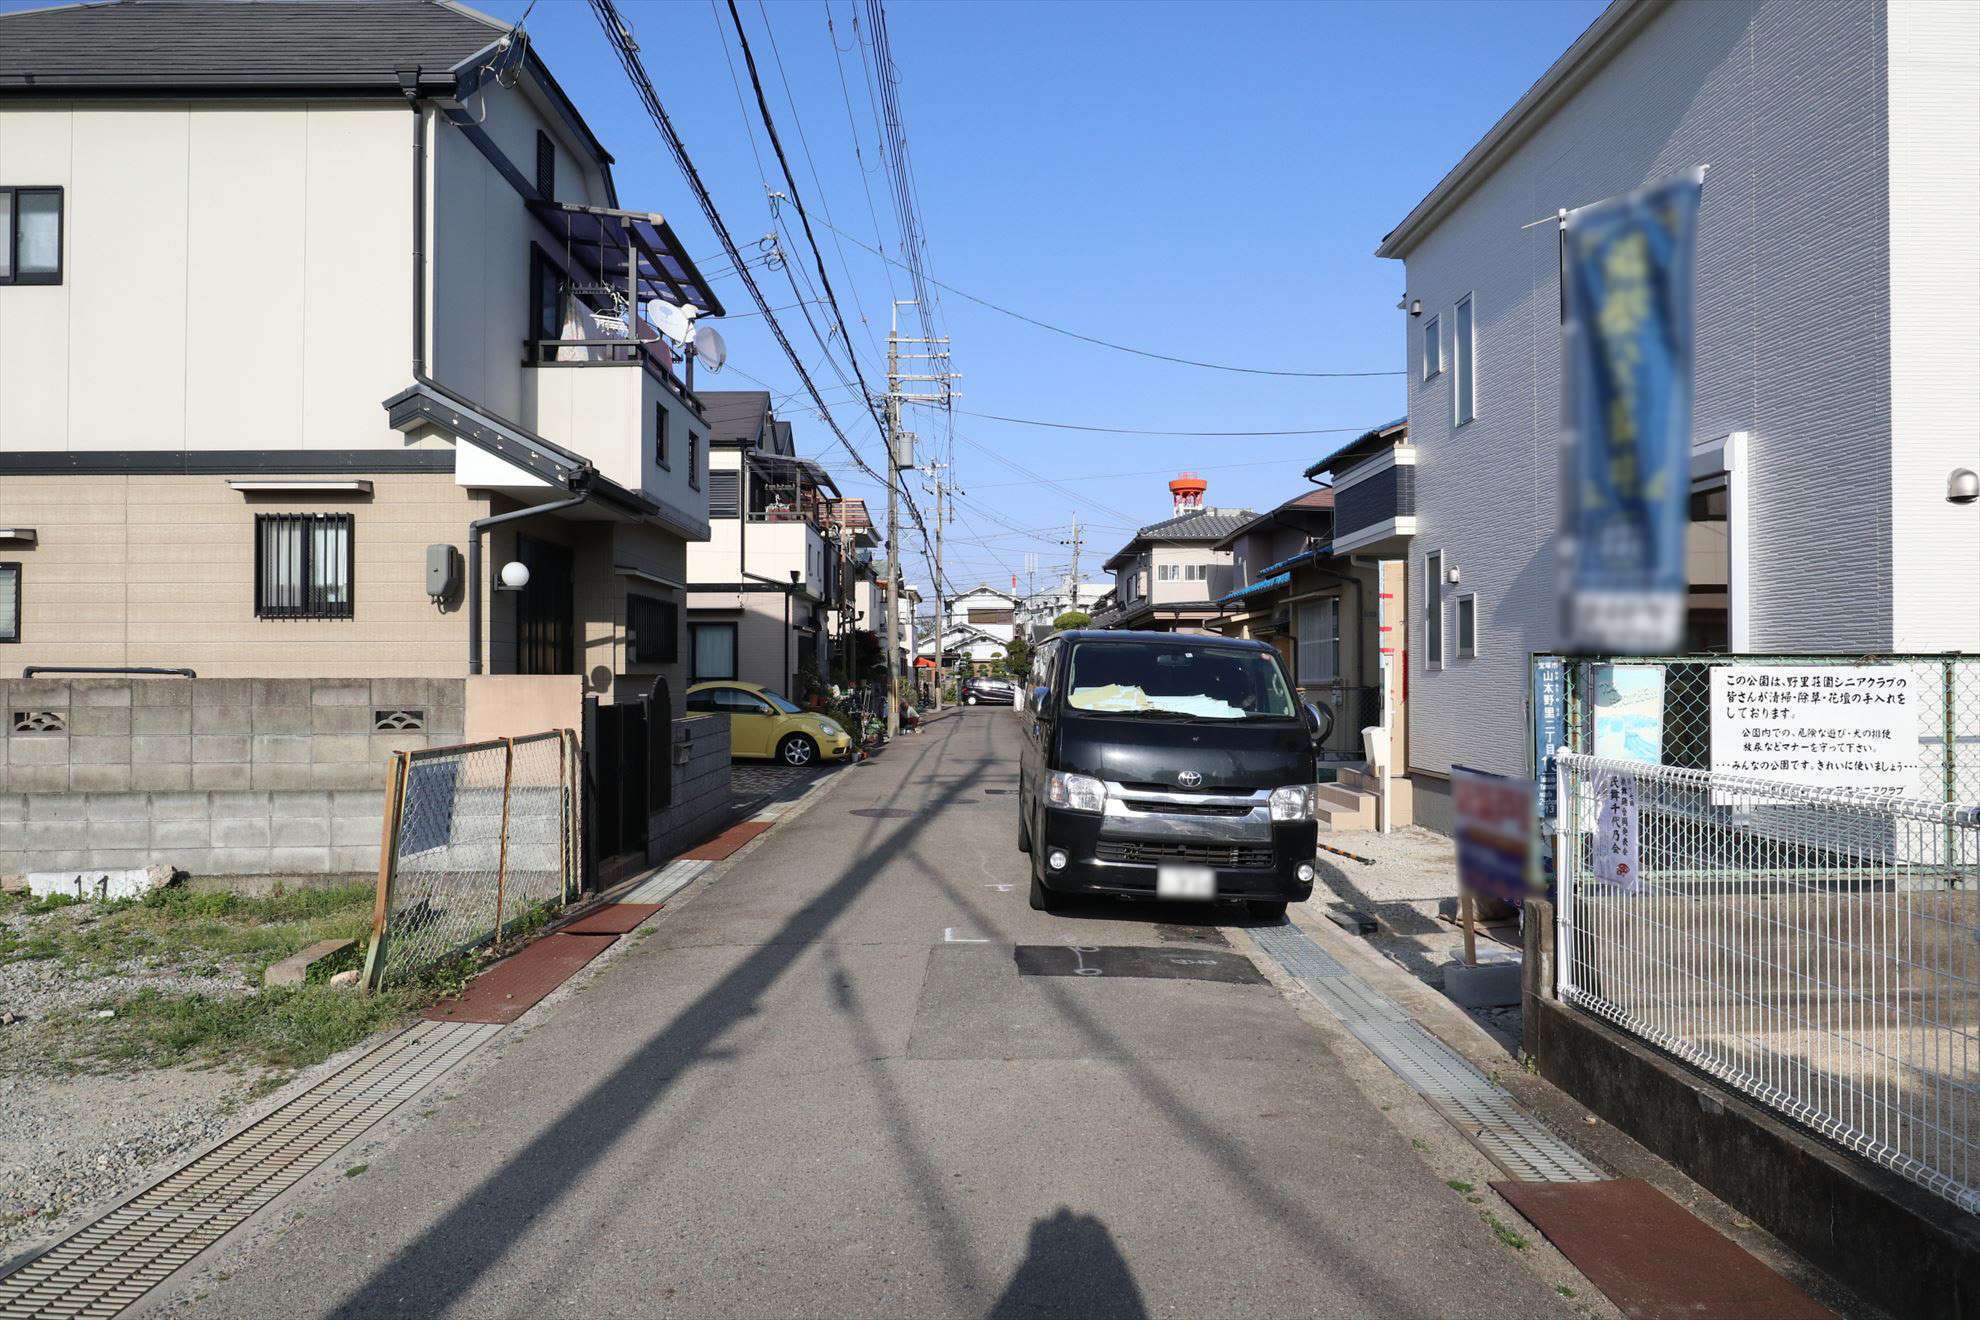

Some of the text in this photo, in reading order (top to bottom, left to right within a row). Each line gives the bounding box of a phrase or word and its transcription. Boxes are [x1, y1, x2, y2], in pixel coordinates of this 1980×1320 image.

[1726, 675, 1907, 688] この公園は、野里荘園シニアクラブの
[1726, 691, 1906, 704] 皆さんが清掃・除草・花壇の手入れを
[1726, 707, 1797, 719] しております。
[1741, 728, 1892, 739] 公園内での、危険な遊び・犬の排便
